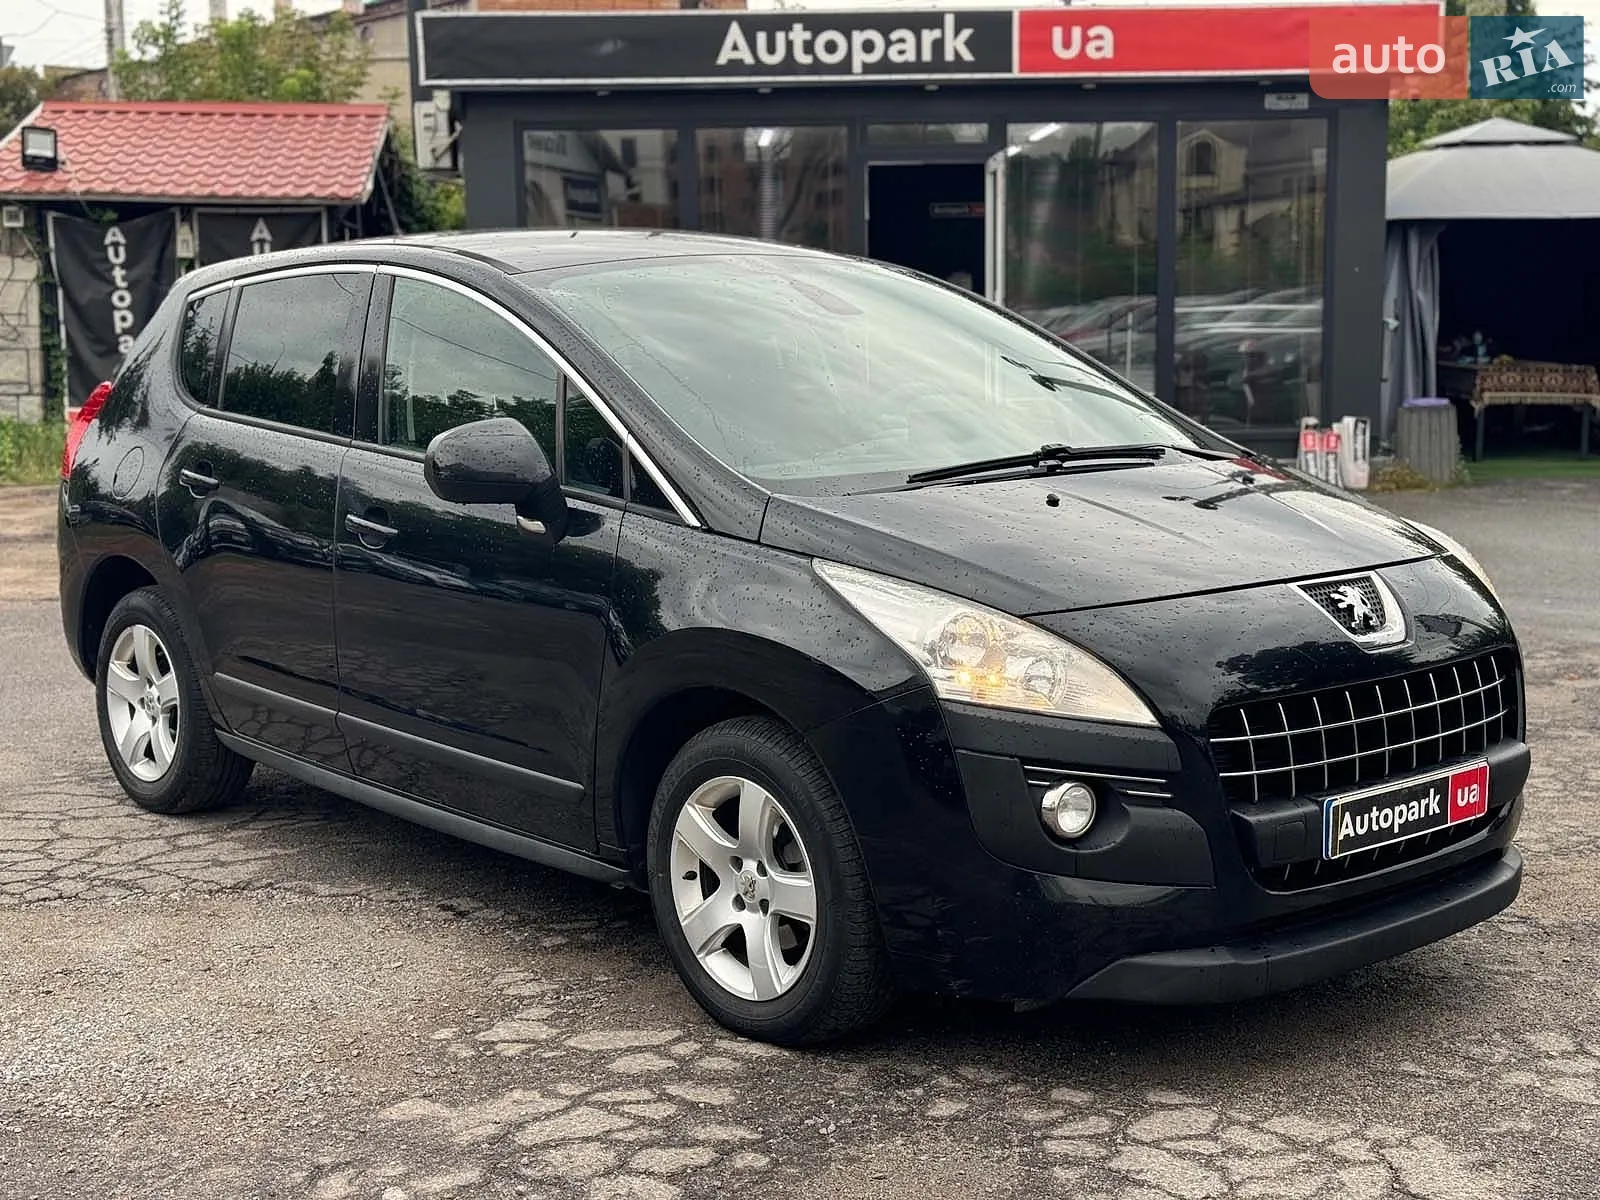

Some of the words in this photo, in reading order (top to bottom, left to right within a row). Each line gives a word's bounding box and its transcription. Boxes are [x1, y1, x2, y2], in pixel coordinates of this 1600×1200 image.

[716, 13, 975, 74] Autopark
[1052, 25, 1115, 60] ua
[104, 226, 136, 355] Autopa
[1338, 787, 1441, 841] Autopark
[1457, 783, 1480, 807] ua
